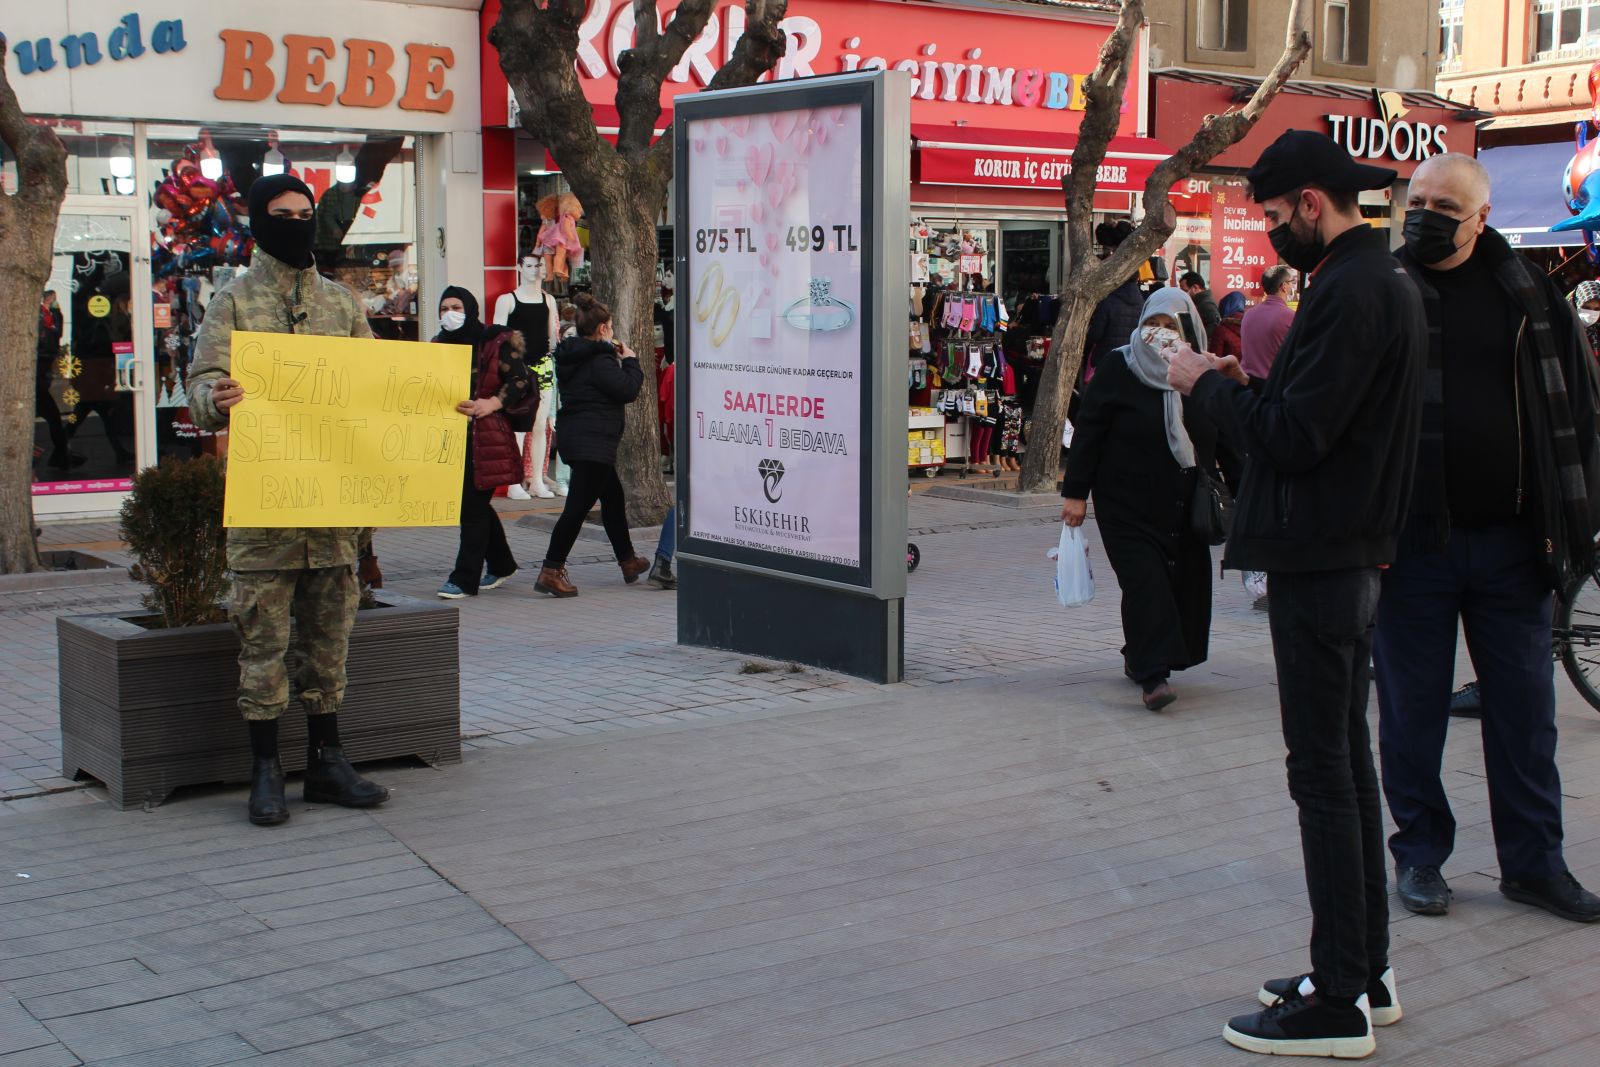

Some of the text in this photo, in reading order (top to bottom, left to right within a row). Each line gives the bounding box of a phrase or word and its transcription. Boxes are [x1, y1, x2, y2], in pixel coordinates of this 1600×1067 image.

[0, 12, 187, 75] unda
[213, 28, 456, 114] BEBE
[1325, 114, 1448, 161] TUDORS
[974, 156, 1127, 183] KORUR İÇ GİYİ BEBE
[1223, 206, 1236, 215] DEV
[1223, 216, 1266, 232] İNDİRİMİ
[695, 227, 758, 254] 875 TL
[785, 225, 858, 252] 499 TL
[1222, 235, 1244, 244] Gömlek
[1222, 245, 1258, 265] 24,90
[1226, 274, 1255, 290] 29,90
[234, 341, 351, 409] SİZİN
[793, 367, 816, 377] KADAR
[723, 389, 825, 420] SAATLERDE
[697, 411, 848, 457] 1 ALANA 1 BEDAVA
[260, 475, 324, 510] BANA
